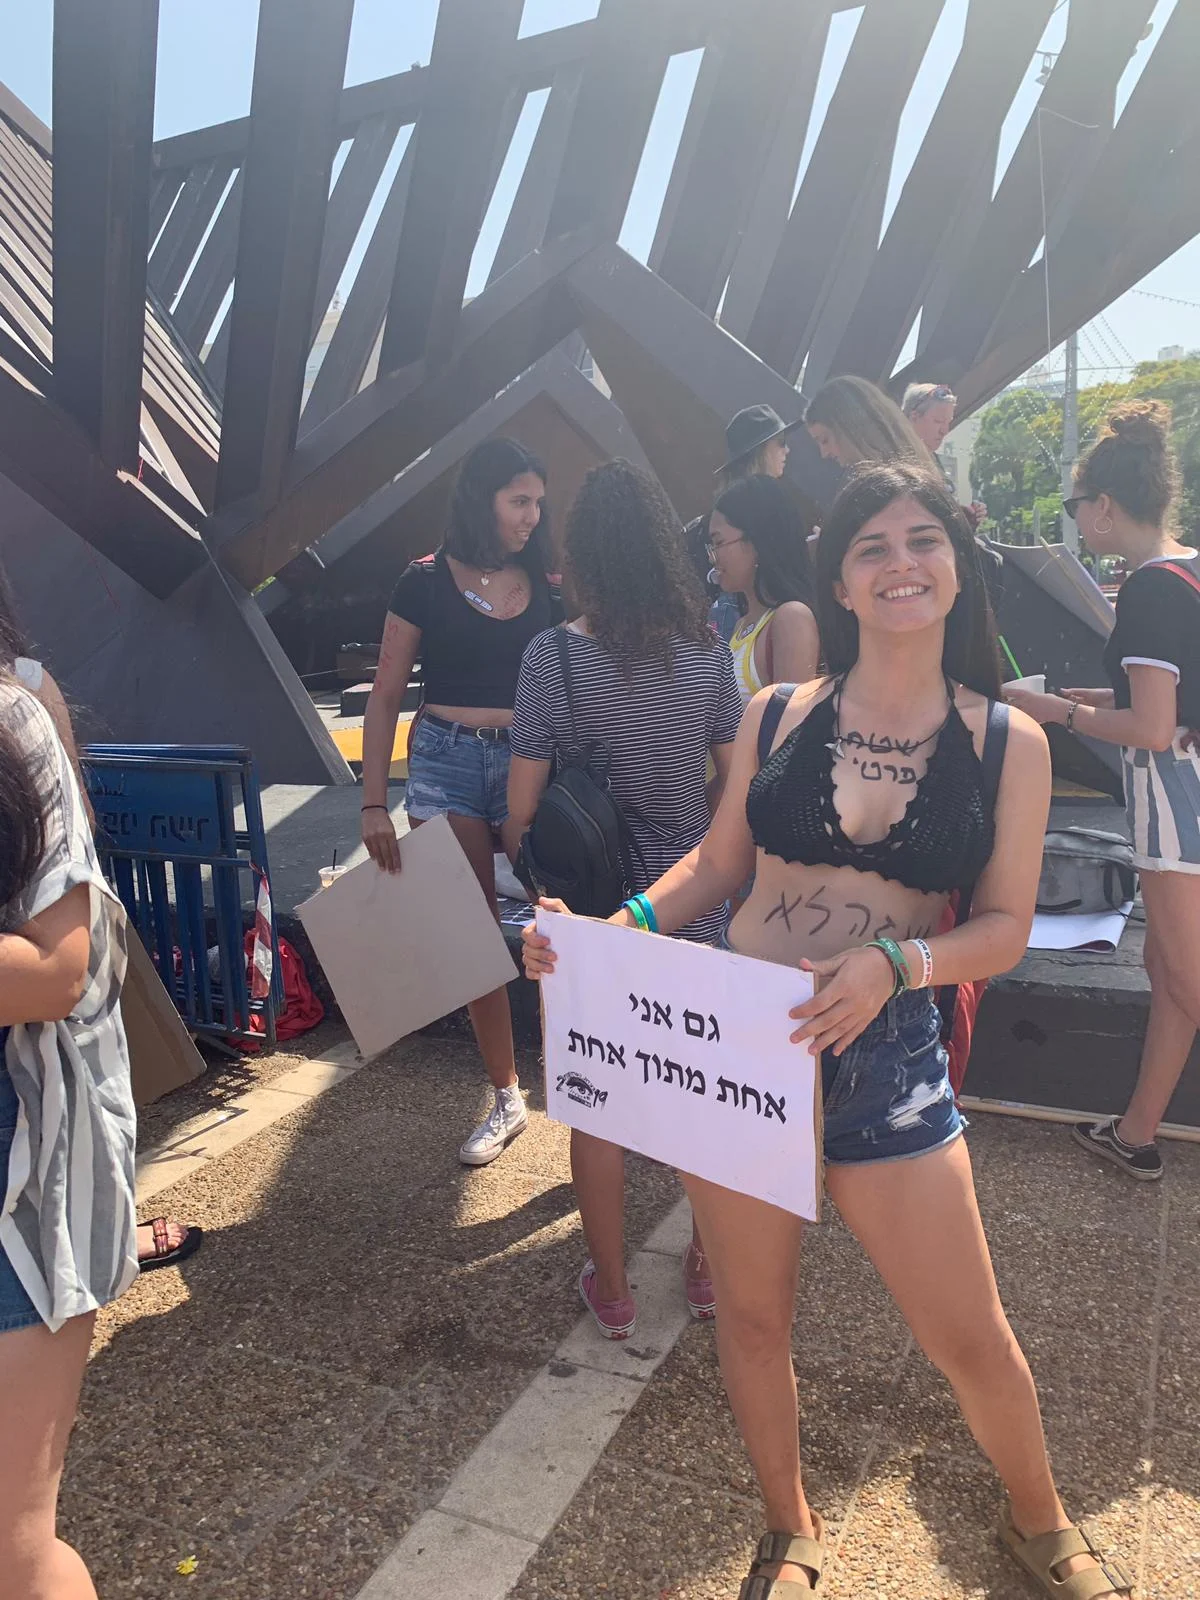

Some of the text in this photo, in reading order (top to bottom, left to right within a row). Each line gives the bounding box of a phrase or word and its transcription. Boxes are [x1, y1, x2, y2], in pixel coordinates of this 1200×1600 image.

[853, 757, 917, 784] פרטי
[629, 993, 721, 1043] גם אני
[568, 1028, 626, 1069] אחת
[635, 1048, 706, 1096] מתוך
[716, 1076, 787, 1124] אחת
